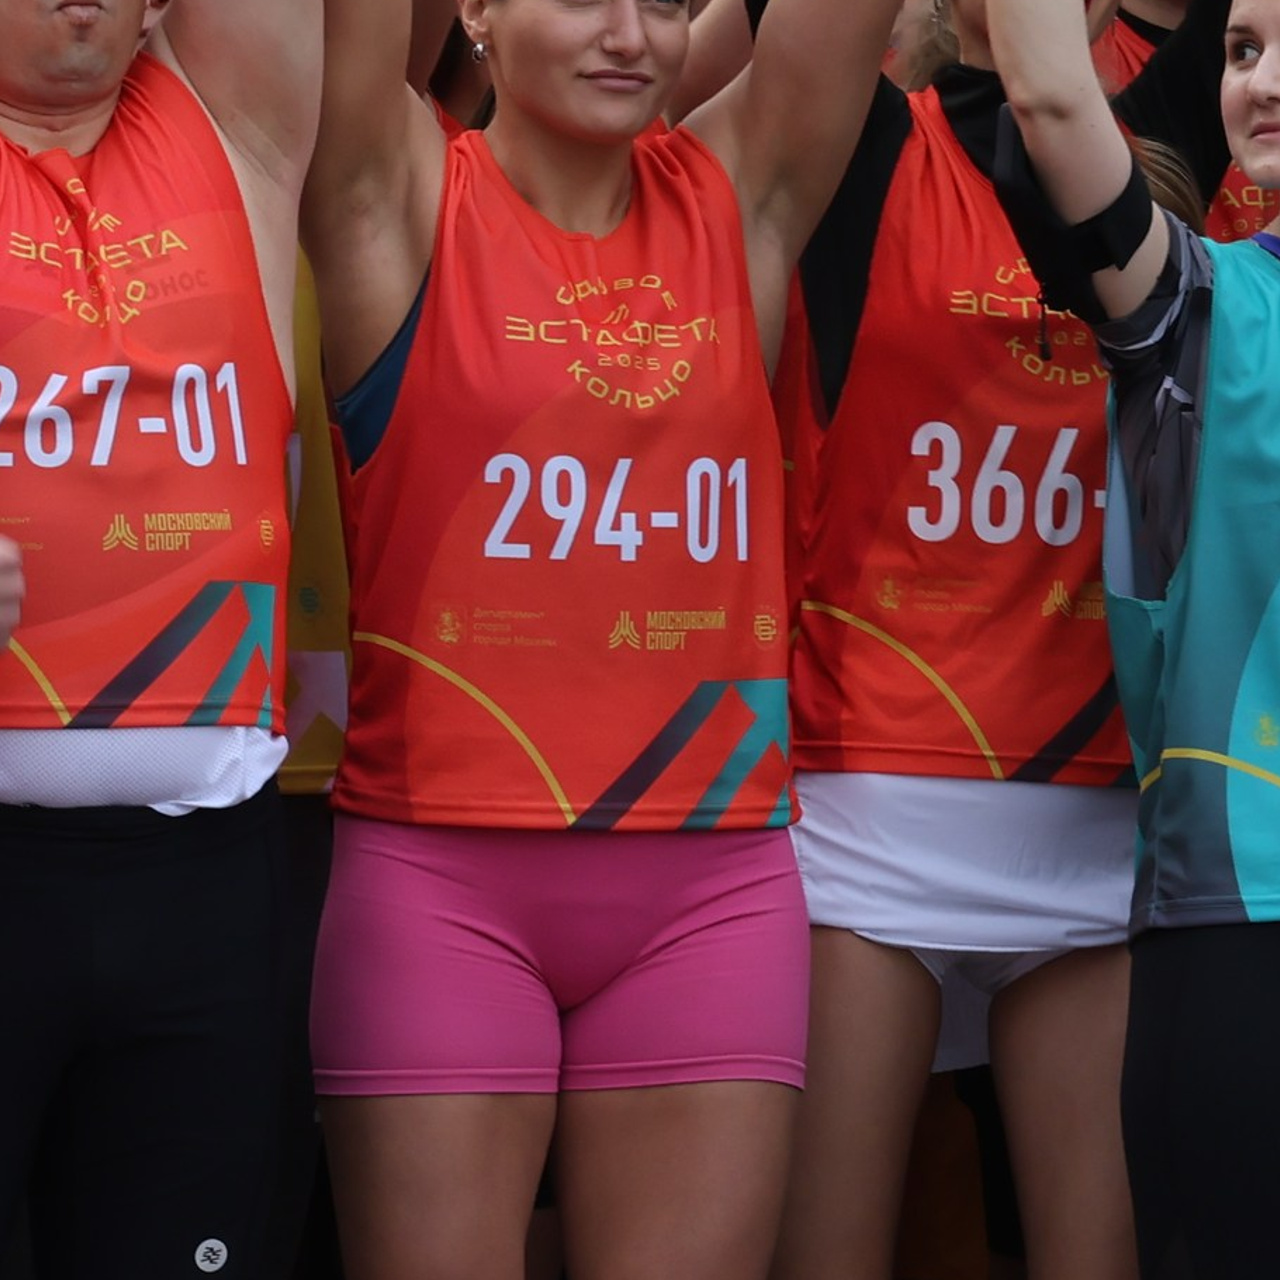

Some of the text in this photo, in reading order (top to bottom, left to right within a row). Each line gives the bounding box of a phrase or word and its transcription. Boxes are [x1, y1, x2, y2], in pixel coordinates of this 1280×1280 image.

[597, 352, 662, 371] 2025
[566, 359, 692, 410] КОЛЬЦО
[483, 452, 749, 564] 294-01
[144, 509, 233, 532] МОСКОВСКИЙ
[144, 532, 192, 552] СПОРТ
[646, 606, 726, 631] МОСКОВСКИЙ
[646, 630, 687, 651] СПОРТ
